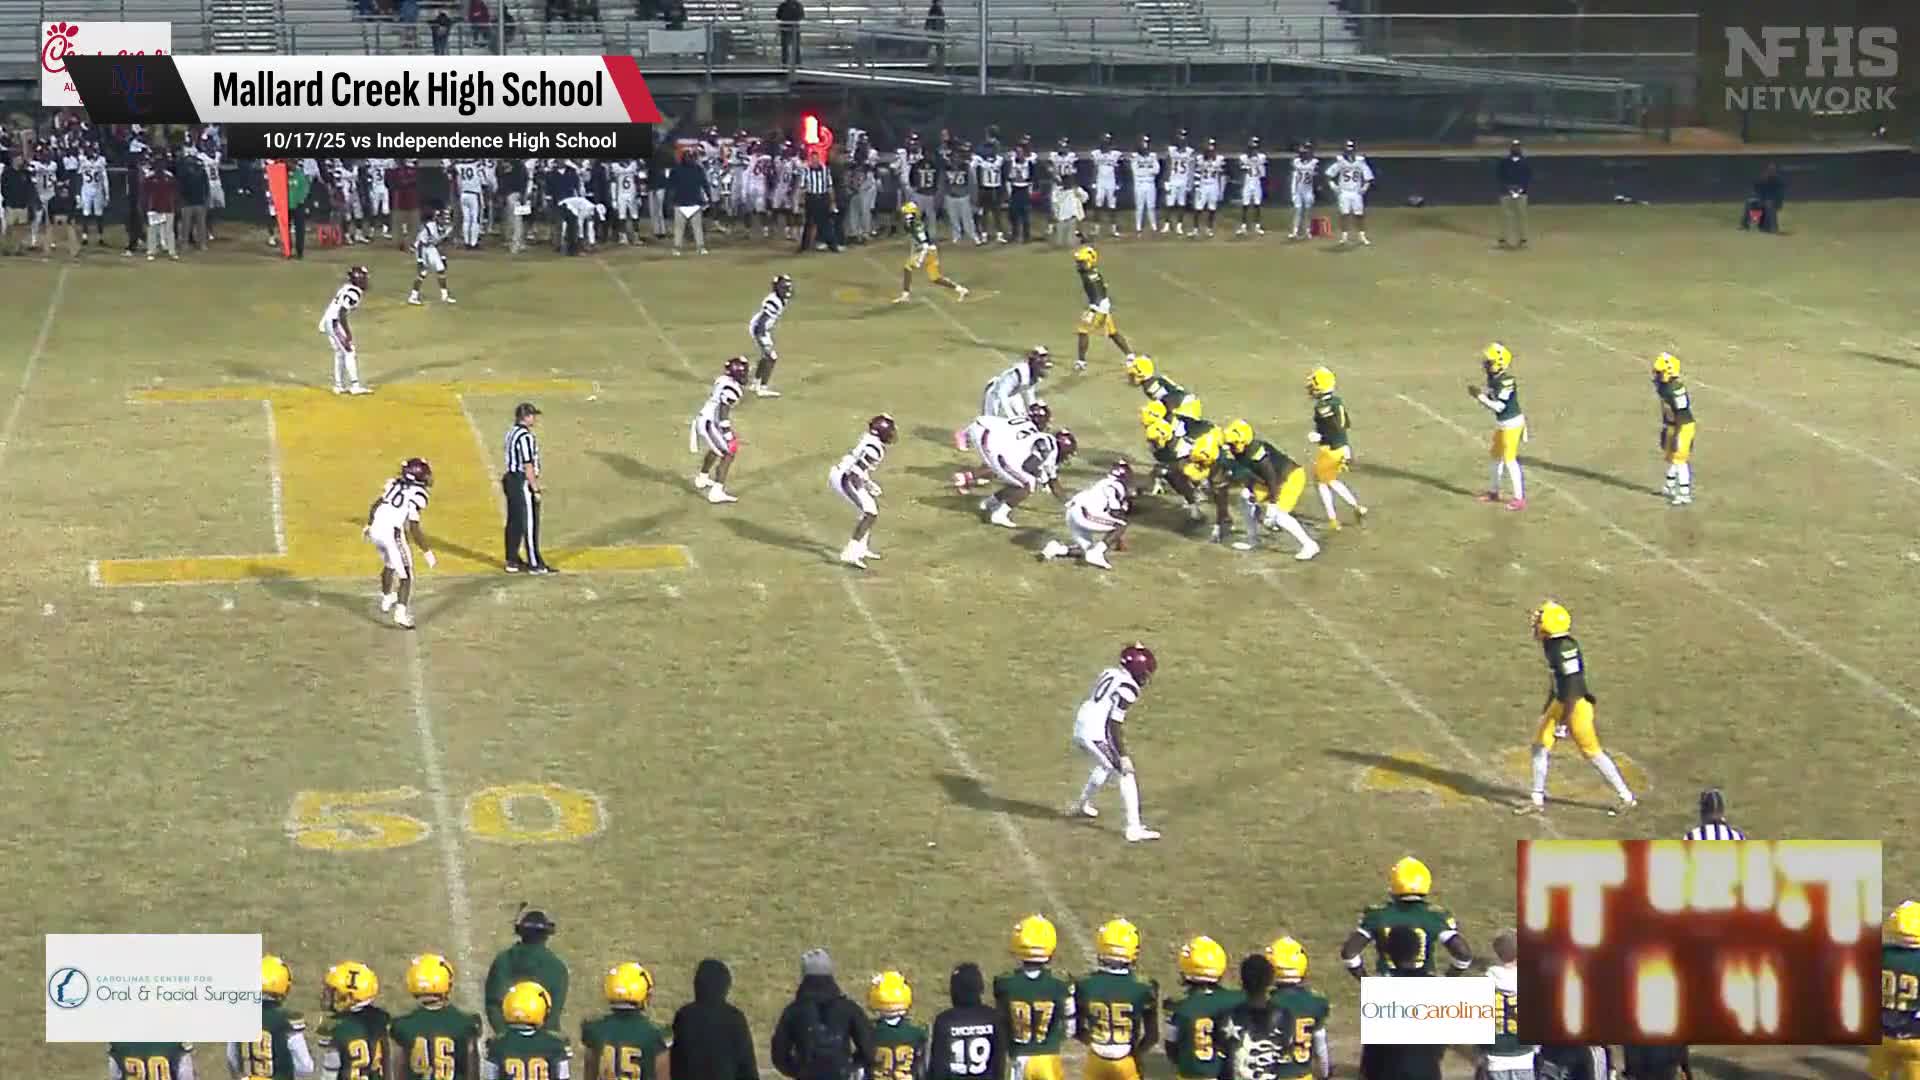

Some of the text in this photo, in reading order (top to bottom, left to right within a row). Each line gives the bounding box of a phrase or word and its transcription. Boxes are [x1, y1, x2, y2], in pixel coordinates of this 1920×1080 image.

[284, 784, 608, 851] 50
[1088, 1002, 1134, 1044] 35
[410, 1036, 456, 1080] 46
[950, 1037, 992, 1075] 19
